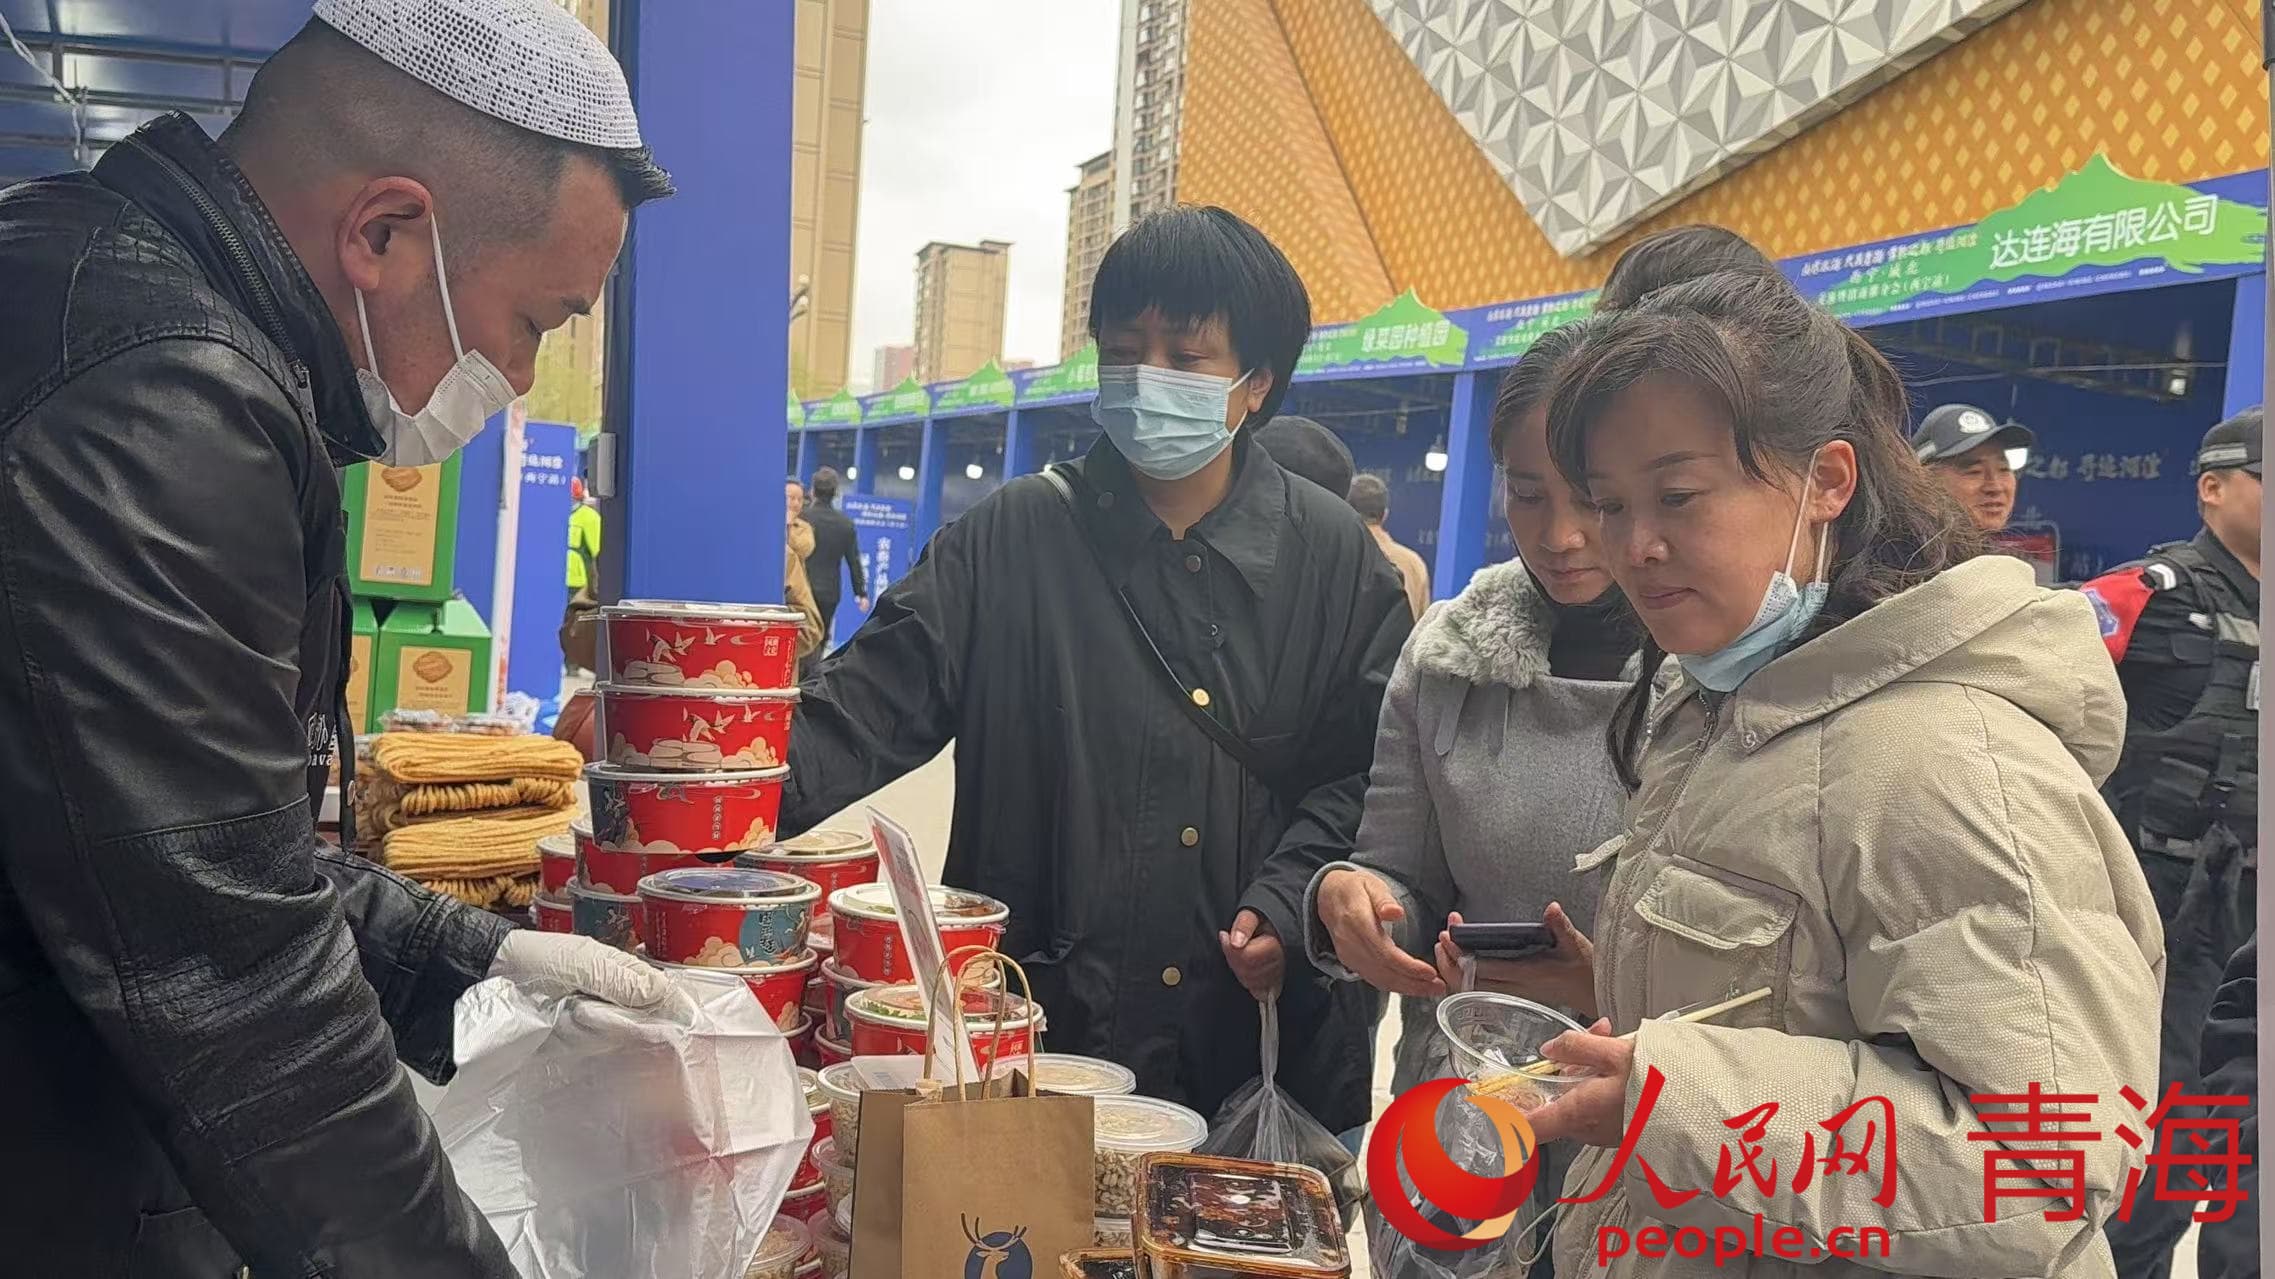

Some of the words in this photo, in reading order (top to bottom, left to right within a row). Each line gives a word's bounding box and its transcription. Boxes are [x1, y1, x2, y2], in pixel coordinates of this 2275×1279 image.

[1989, 194, 2219, 270] 达连海有限公司
